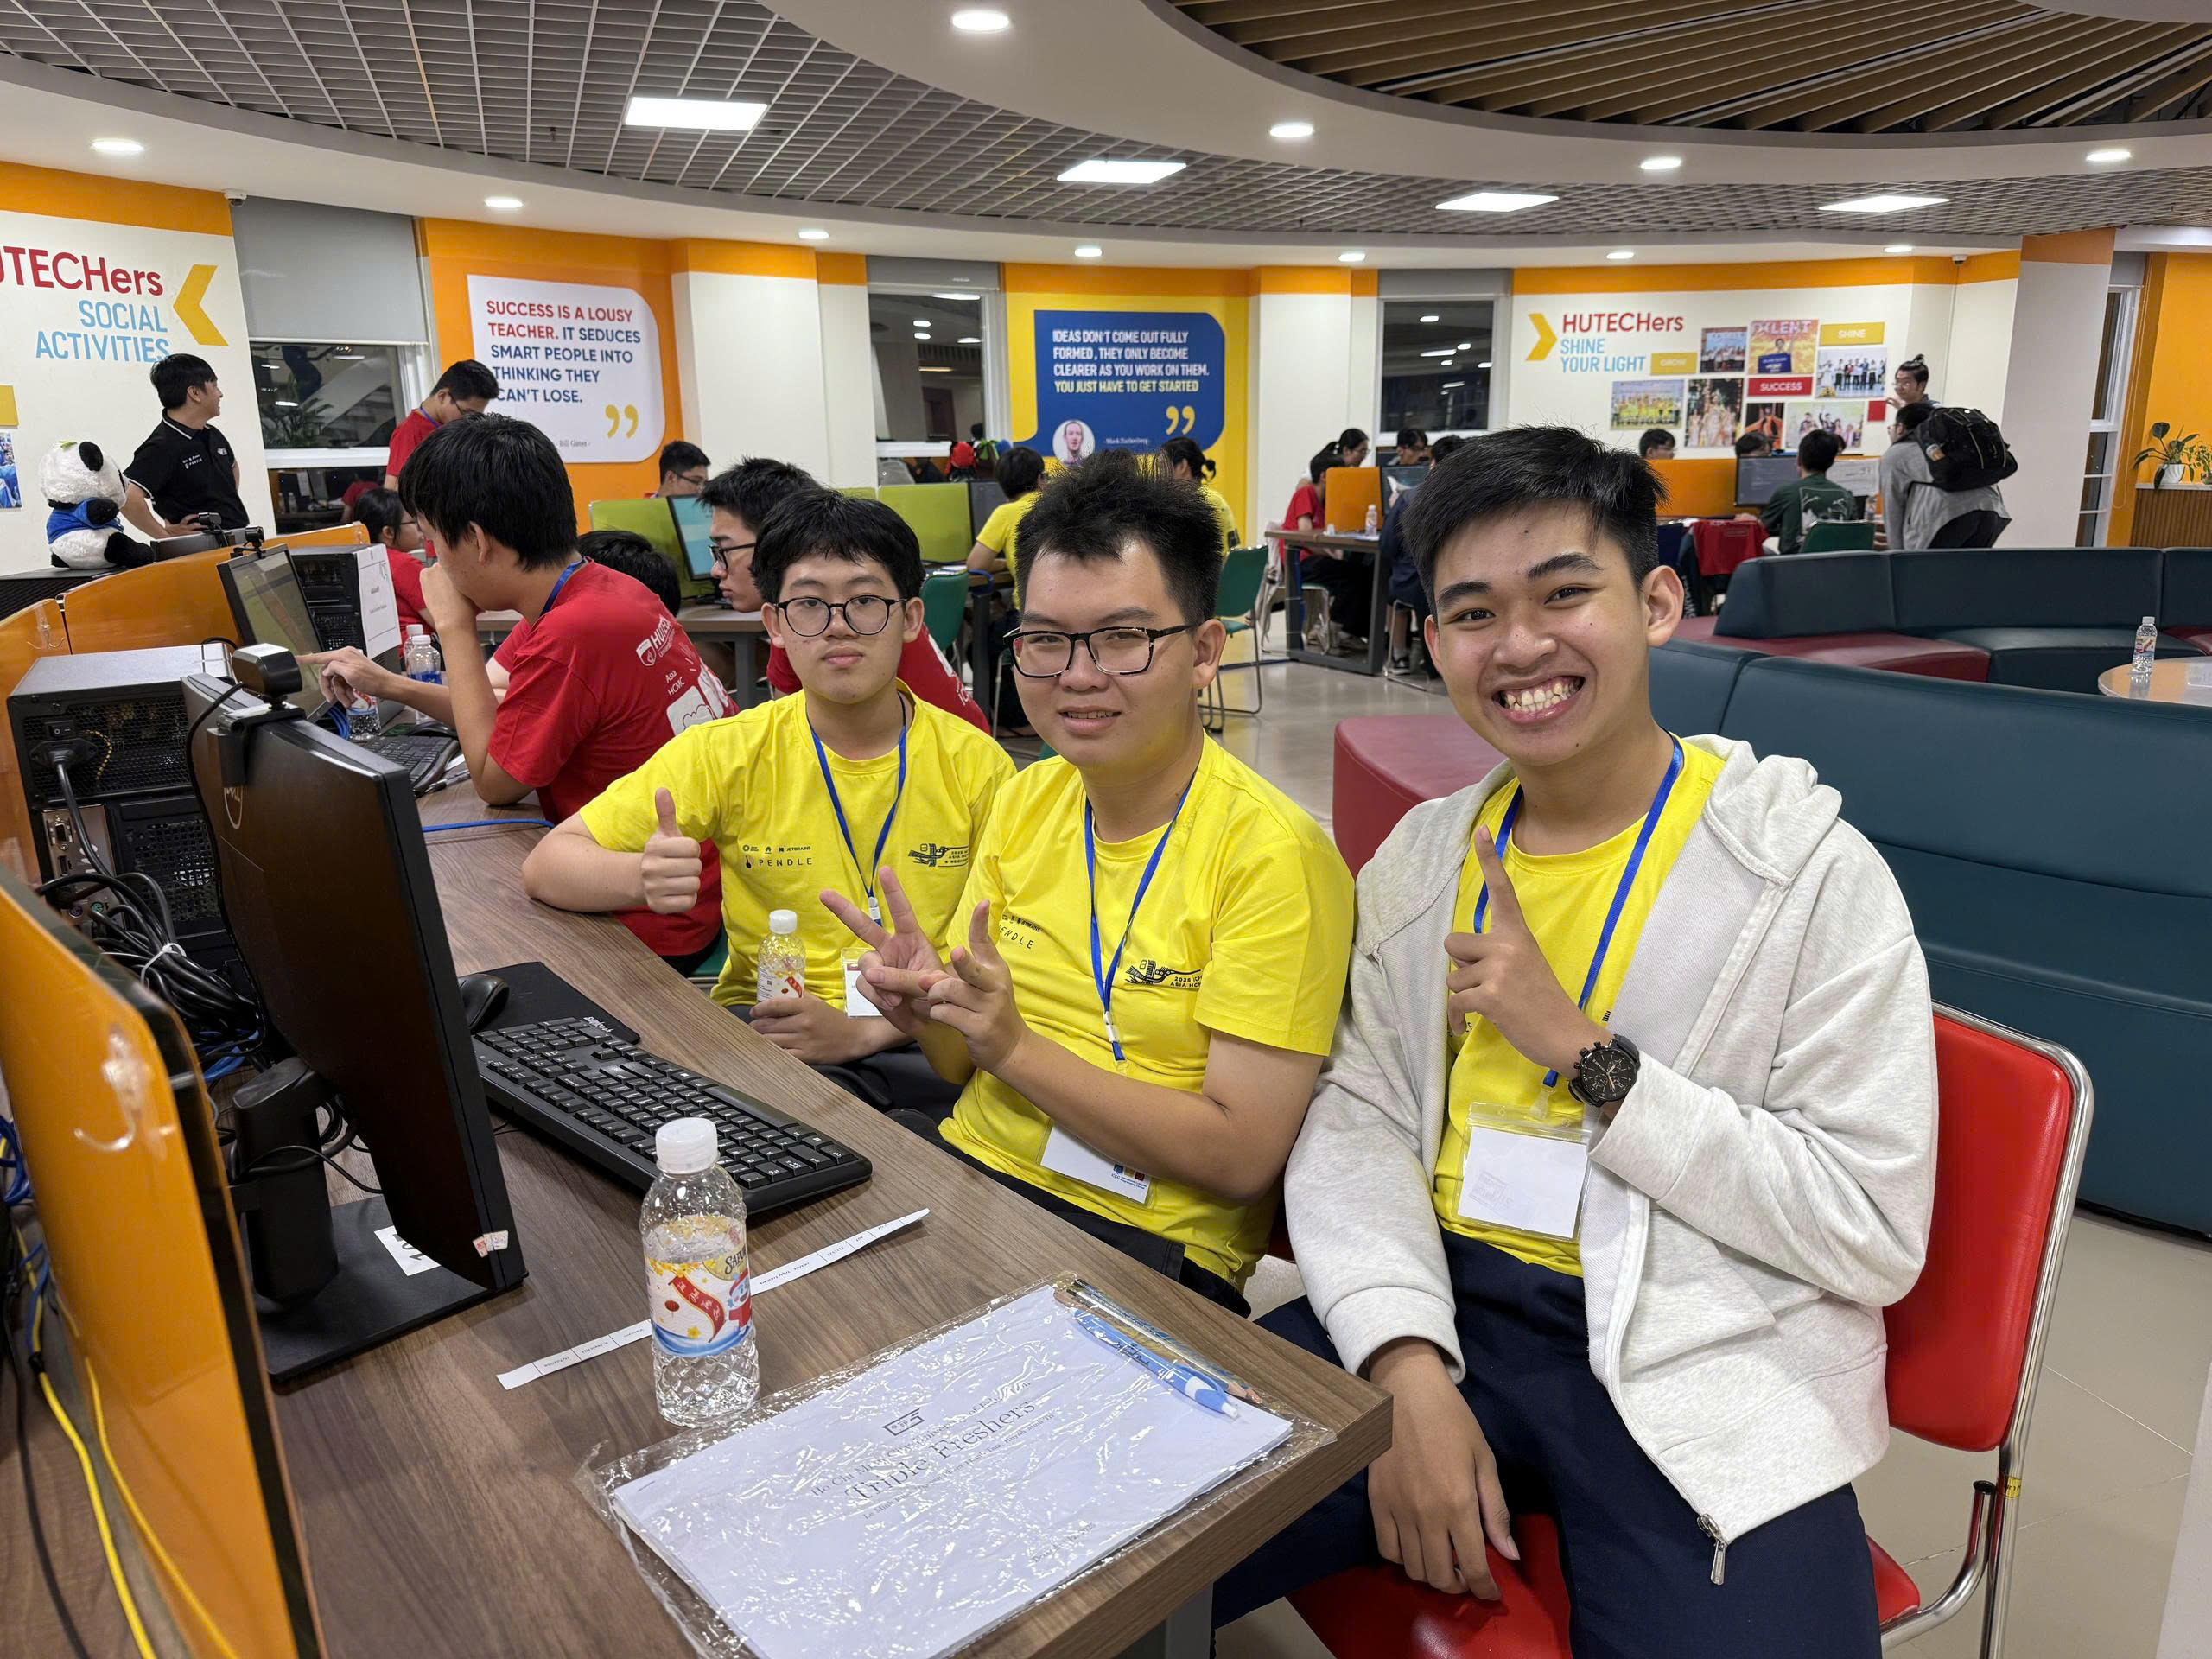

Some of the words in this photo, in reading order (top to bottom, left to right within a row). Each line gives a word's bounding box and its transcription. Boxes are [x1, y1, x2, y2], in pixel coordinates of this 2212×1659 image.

[0, 245, 164, 296] TECHers
[78, 300, 168, 333] SOCIAL
[486, 301, 555, 318] SUCCESS
[557, 305, 571, 319] IS
[575, 307, 585, 320] A
[588, 307, 633, 322] LOUSY
[1561, 312, 1684, 334] HUTECHers
[488, 322, 559, 340] TEACHER.
[563, 327, 575, 340] IT
[579, 327, 641, 343] SEDUCES
[1052, 329, 1081, 343] IDEAS
[1082, 330, 1112, 343] DON'T
[1112, 331, 1139, 343] COME
[1140, 331, 1160, 343] OUT
[1160, 331, 1189, 343] FULLY
[1838, 329, 1866, 339] SHINE
[35, 331, 170, 363] ACTIVITIES
[491, 345, 543, 360] SMART
[545, 346, 598, 362] PEOPLE
[601, 349, 633, 363] INTO
[1098, 347, 1123, 359] THEY
[1124, 347, 1148, 359] ONLY
[1149, 347, 1188, 359] BECOME
[1560, 338, 1605, 355] SHINE
[1053, 363, 1098, 377] CLEARER
[1099, 364, 1113, 376] AS
[1114, 364, 1134, 376] YOU
[1135, 364, 1164, 376] WORK
[1165, 364, 1179, 376] ON
[1180, 364, 1210, 376] THEM.
[1560, 356, 1600, 373] YOUR
[1604, 356, 1646, 372] LIGHT
[492, 365, 562, 382] THINKING
[564, 368, 600, 383] THEY
[1054, 380, 1075, 392] YOU
[1075, 380, 1097, 392] JUST
[1099, 380, 1124, 392] HAVE
[1126, 380, 1138, 392] TO
[1139, 380, 1157, 392] GET
[1158, 380, 1199, 392] STARTED
[1759, 381, 1803, 391] SUCCESS
[496, 389, 538, 403] CAN'T
[543, 390, 583, 404] LOSE.
[665, 670, 677, 683] Asia
[667, 677, 686, 696] HCMC
[759, 857, 813, 867] PENDLE
[999, 924, 1034, 950] ENDLE
[844, 1457, 931, 1500] Triple
[929, 1402, 1035, 1460] Freshers
[810, 1484, 830, 1497] Ho
[831, 1472, 855, 1486] Chi
